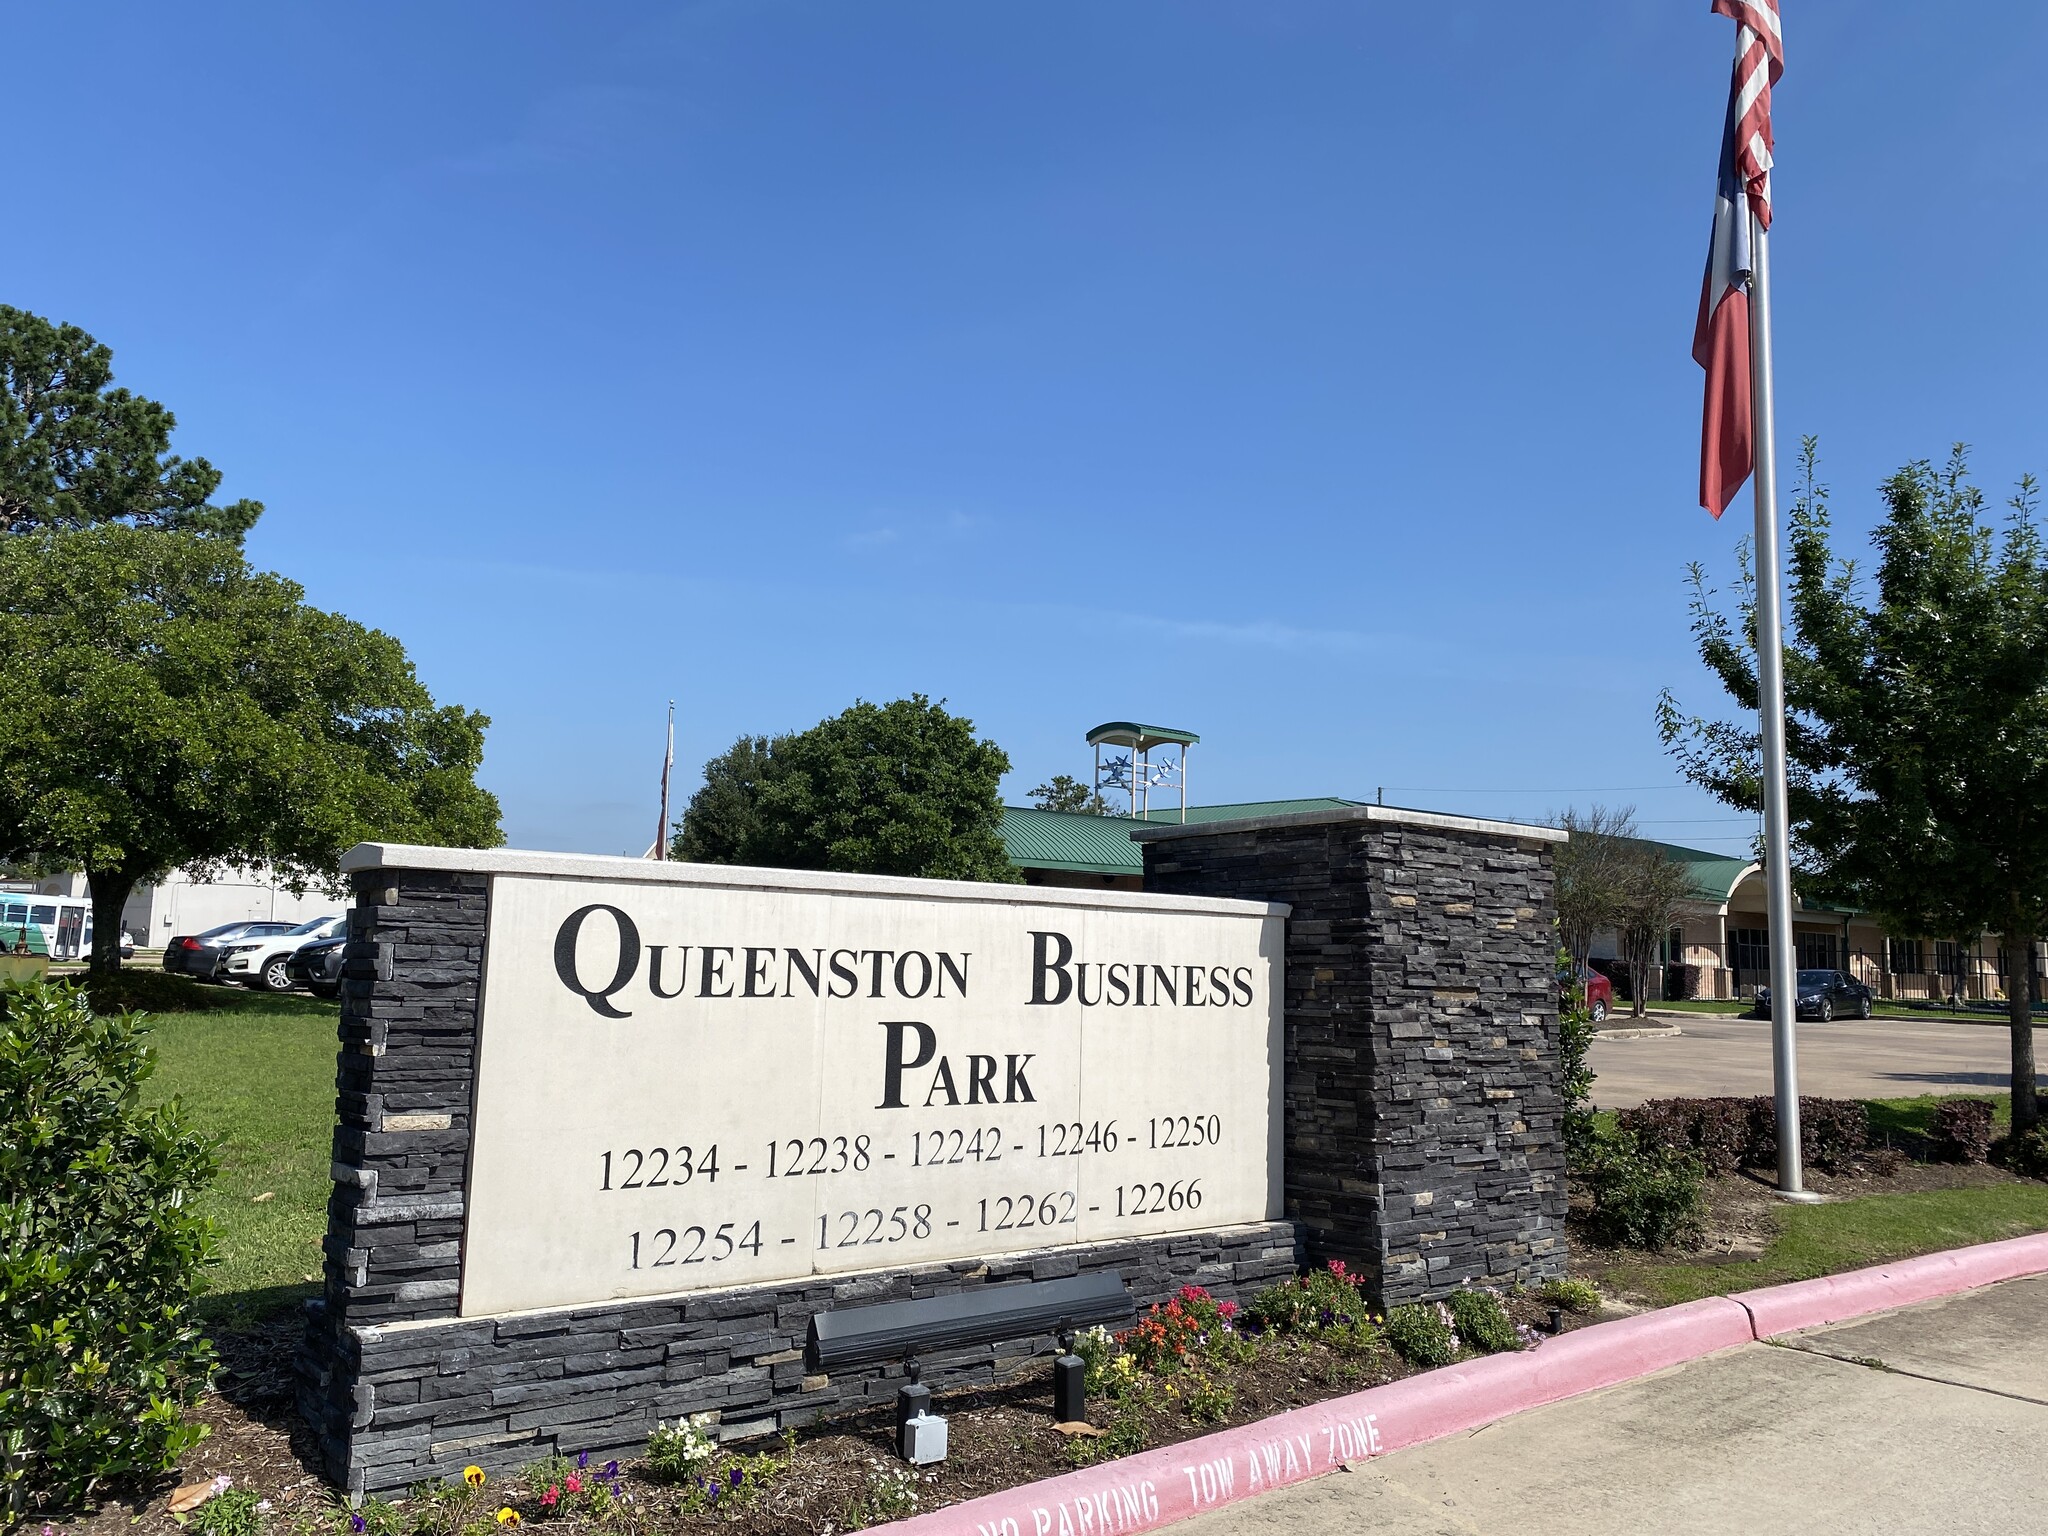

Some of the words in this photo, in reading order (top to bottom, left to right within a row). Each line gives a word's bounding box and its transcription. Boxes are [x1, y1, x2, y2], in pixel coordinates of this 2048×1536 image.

[554, 904, 973, 1019] QUEENSTON
[1024, 931, 1254, 1008] BUSINESS
[874, 1021, 1038, 1110] PARK
[599, 1144, 720, 1191] 12234
[766, 1134, 871, 1179] 12238
[911, 1126, 1002, 1168] 12242
[1037, 1119, 1118, 1158] 12246
[1148, 1114, 1221, 1149] 12250
[627, 1220, 764, 1271] 12254
[816, 1203, 932, 1251] 12258
[976, 1191, 1077, 1232] 12262
[1115, 1178, 1202, 1218] 12266
[1031, 1480, 1160, 1536] PARKING
[1183, 1456, 1235, 1507] TOW
[1248, 1432, 1313, 1491] AWAY
[1321, 1413, 1383, 1464] ZONE
